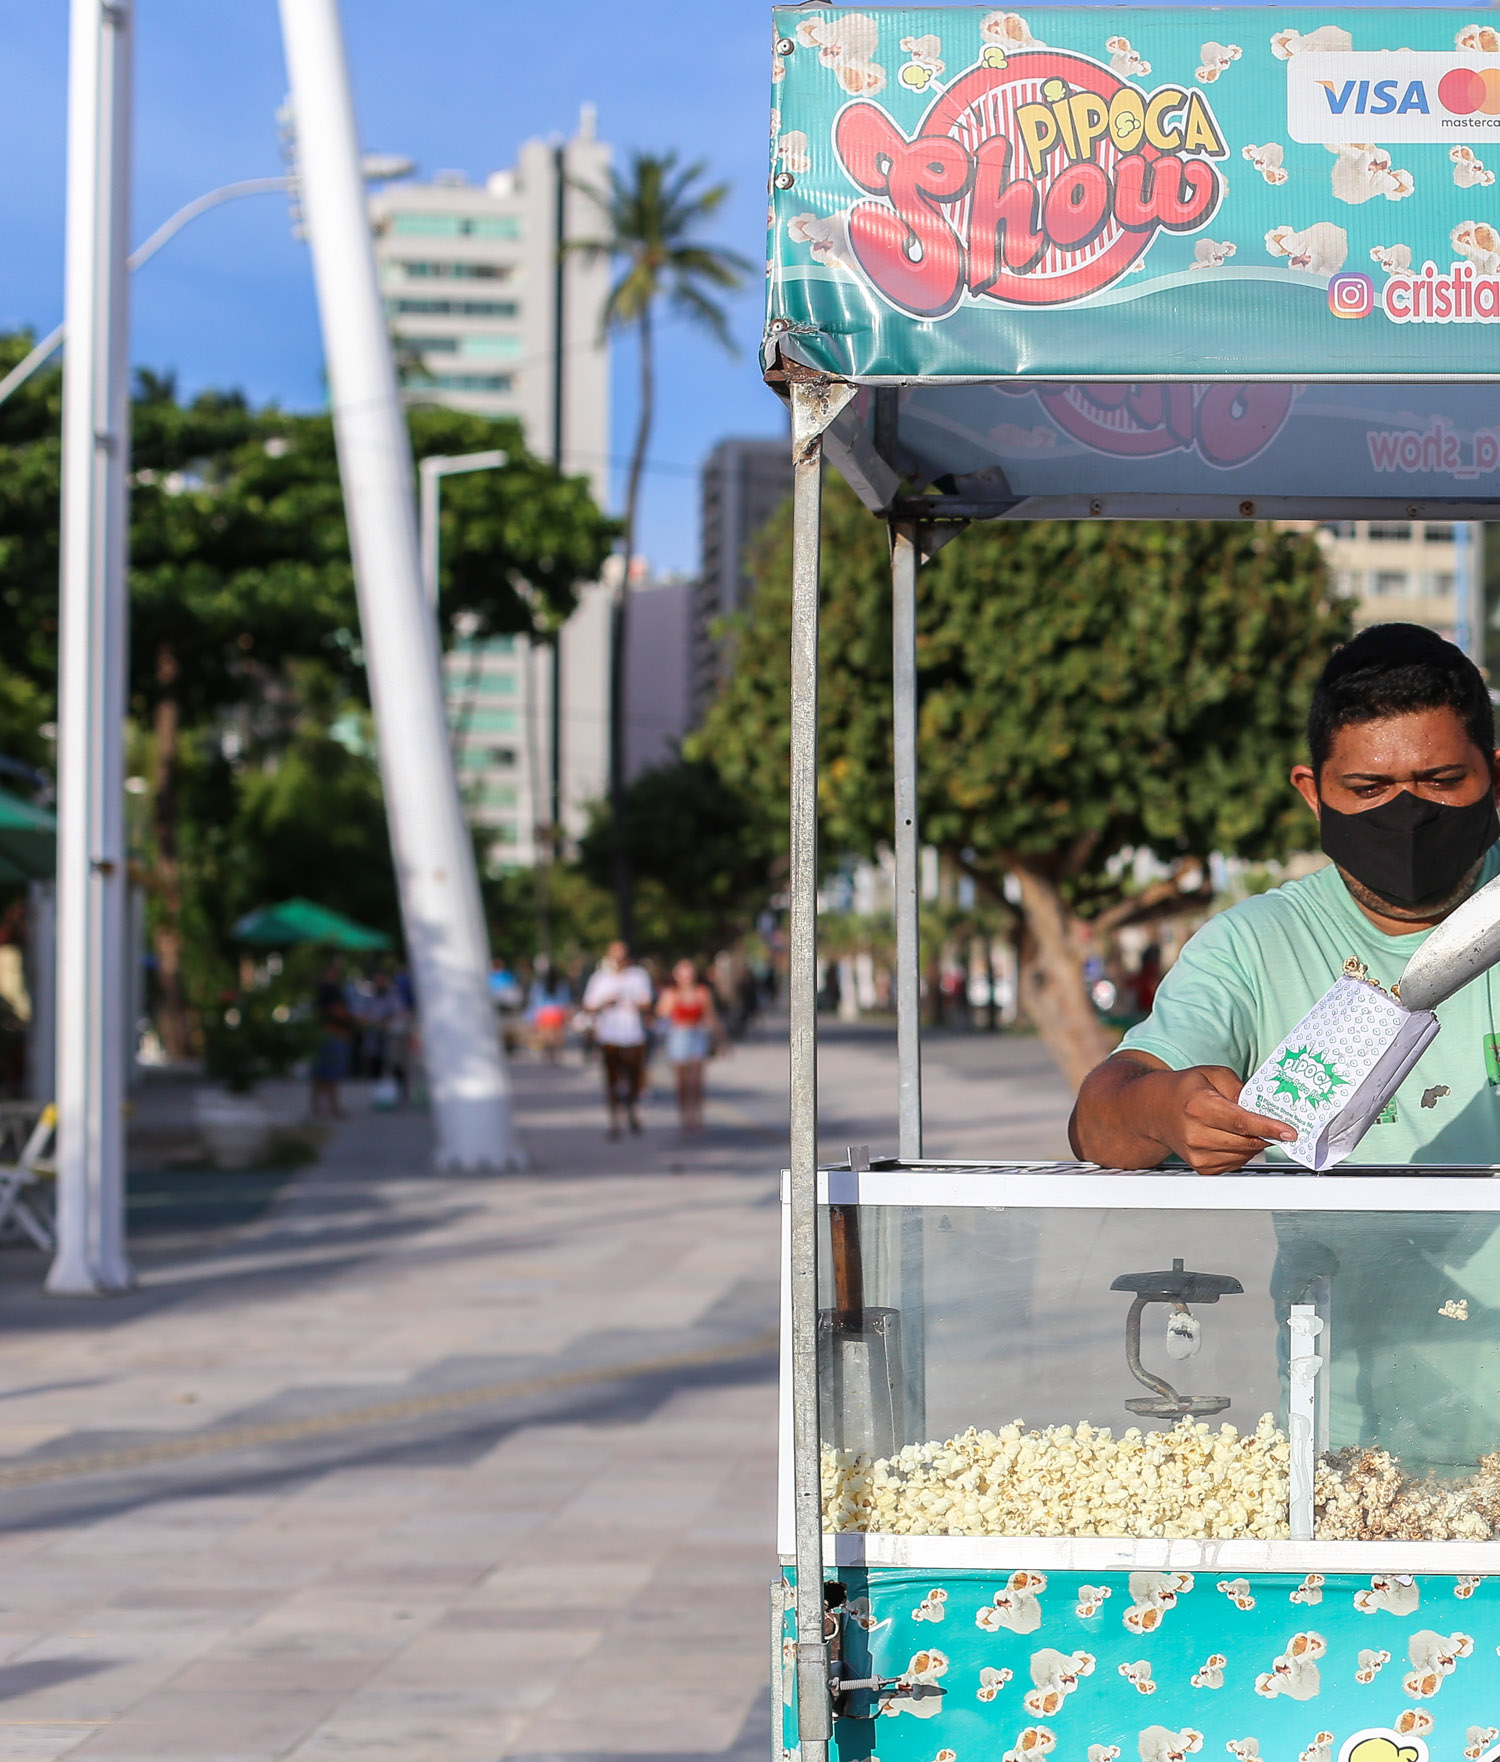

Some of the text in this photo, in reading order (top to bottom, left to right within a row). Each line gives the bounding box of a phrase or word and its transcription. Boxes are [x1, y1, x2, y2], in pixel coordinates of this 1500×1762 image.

[1314, 80, 1430, 114] VISA
[836, 101, 1222, 318] Show
[1282, 1058, 1333, 1094] PIPOCA
